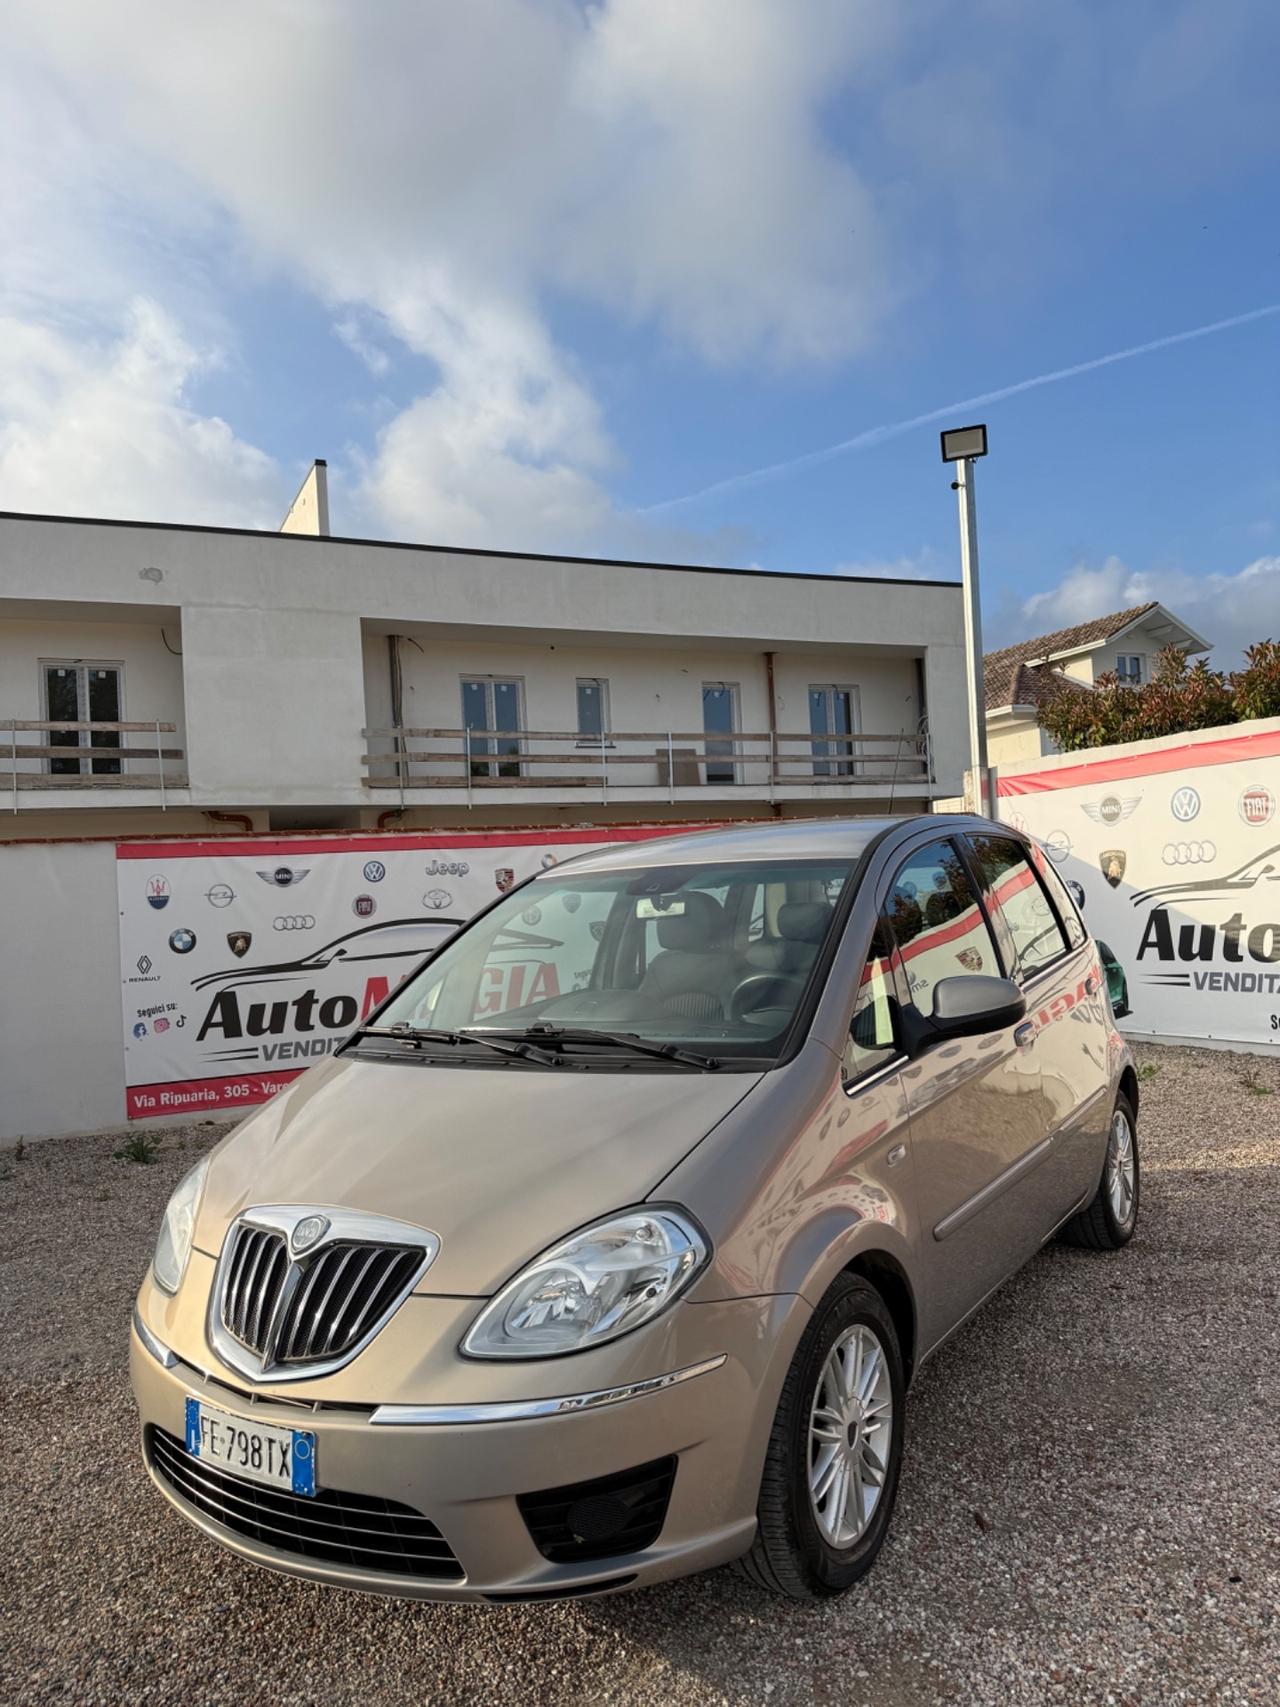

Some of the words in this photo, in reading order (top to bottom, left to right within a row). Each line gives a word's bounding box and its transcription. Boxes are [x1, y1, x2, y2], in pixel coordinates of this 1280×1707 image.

[1101, 805, 1120, 815] MINI
[1246, 797, 1269, 817] FIAT
[425, 860, 470, 877] Jeep
[1136, 909, 1280, 963] Auto
[1193, 971, 1280, 994] VENDIT
[134, 1095, 155, 1108] Via
[160, 1089, 220, 1106] Ripuaria,
[224, 1084, 250, 1099] 305
